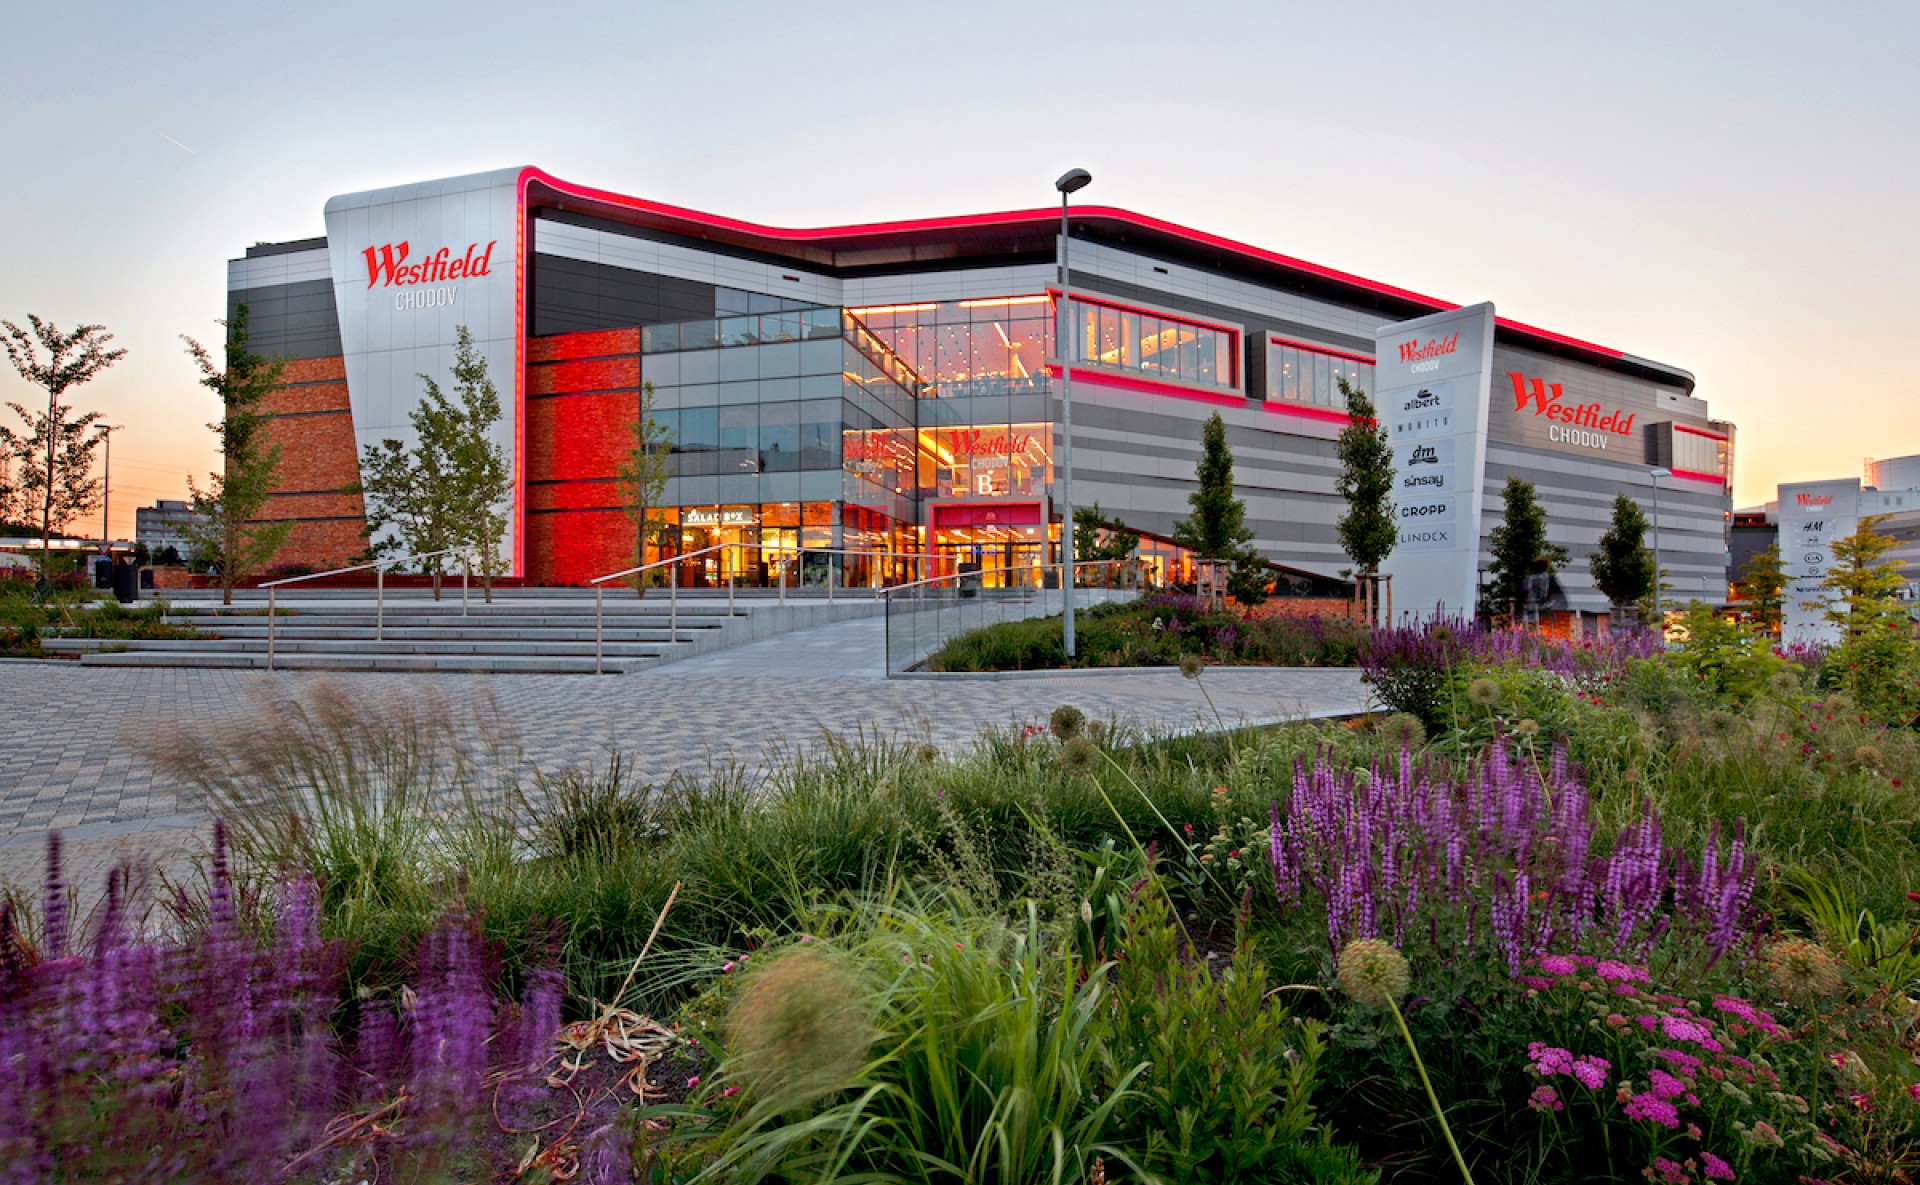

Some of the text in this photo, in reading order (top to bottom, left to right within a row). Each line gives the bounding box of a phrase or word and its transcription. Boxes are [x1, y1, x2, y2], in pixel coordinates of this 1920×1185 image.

[361, 240, 497, 290] Westfield
[396, 286, 458, 311] CHODOV
[1399, 331, 1460, 364] Westfield
[1404, 395, 1441, 411] albert
[1504, 371, 1638, 436] Westfield
[949, 429, 1030, 456] Westfield
[1549, 425, 1608, 449] CHODOV
[1411, 445, 1437, 460] dm
[976, 474, 993, 495] B
[1404, 475, 1444, 488] sinsay
[1402, 504, 1447, 518] CROPP
[1401, 531, 1448, 543] LINDEX
